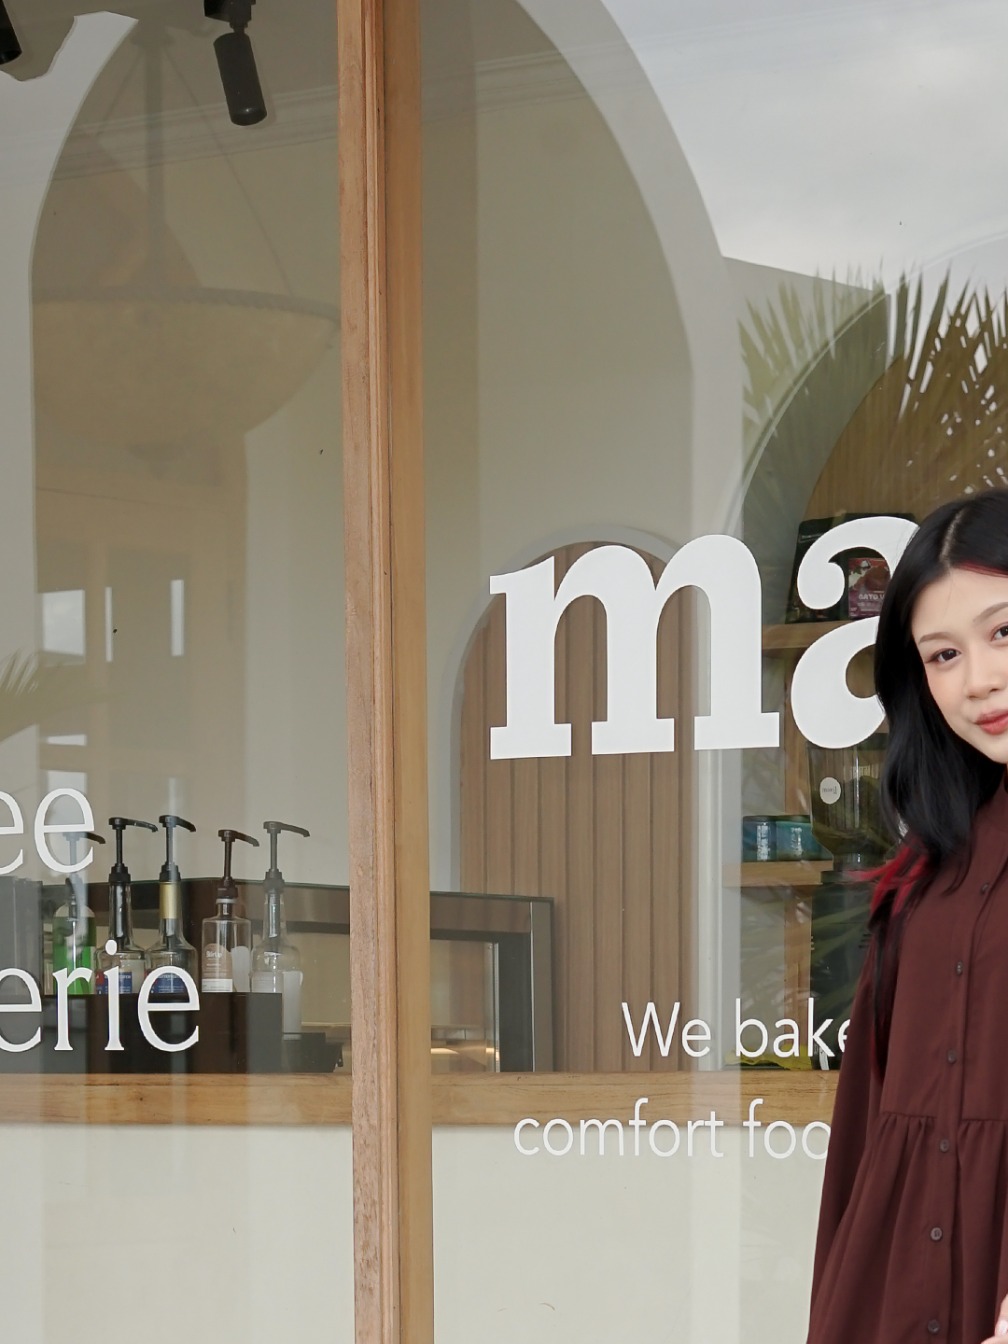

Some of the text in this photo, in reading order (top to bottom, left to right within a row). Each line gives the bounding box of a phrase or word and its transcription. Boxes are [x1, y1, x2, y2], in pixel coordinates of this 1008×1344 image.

[0, 939, 200, 1053] erie
[621, 1001, 712, 1058] We
[513, 1097, 724, 1158] comfort
